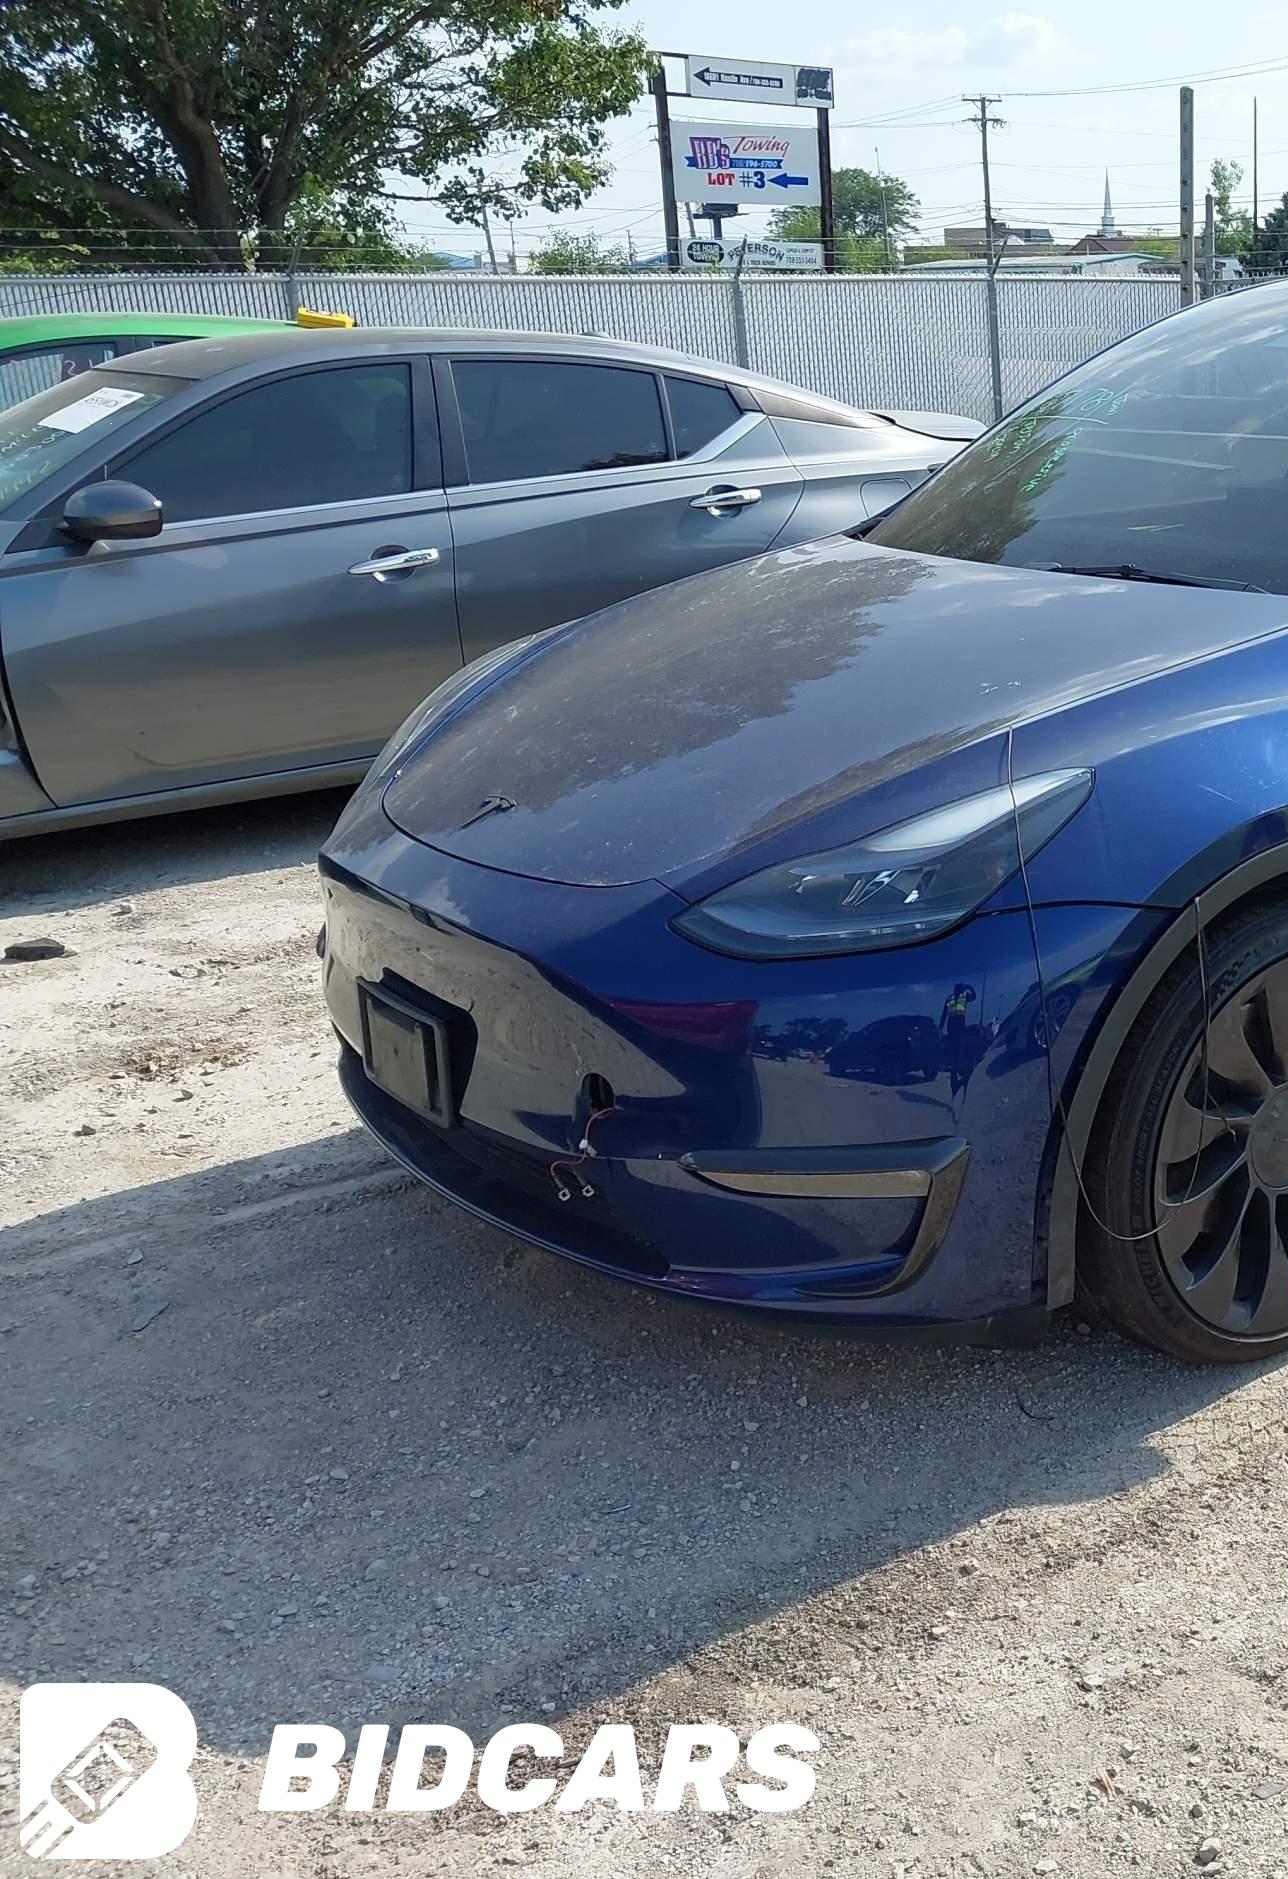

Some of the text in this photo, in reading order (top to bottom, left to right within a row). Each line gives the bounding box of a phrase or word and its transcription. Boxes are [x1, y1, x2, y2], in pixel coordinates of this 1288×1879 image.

[723, 135, 790, 157] Towing
[708, 171, 766, 189] LOT #3
[727, 243, 785, 262] PEERSON
[1136, 1123, 1152, 1166] SPORT
